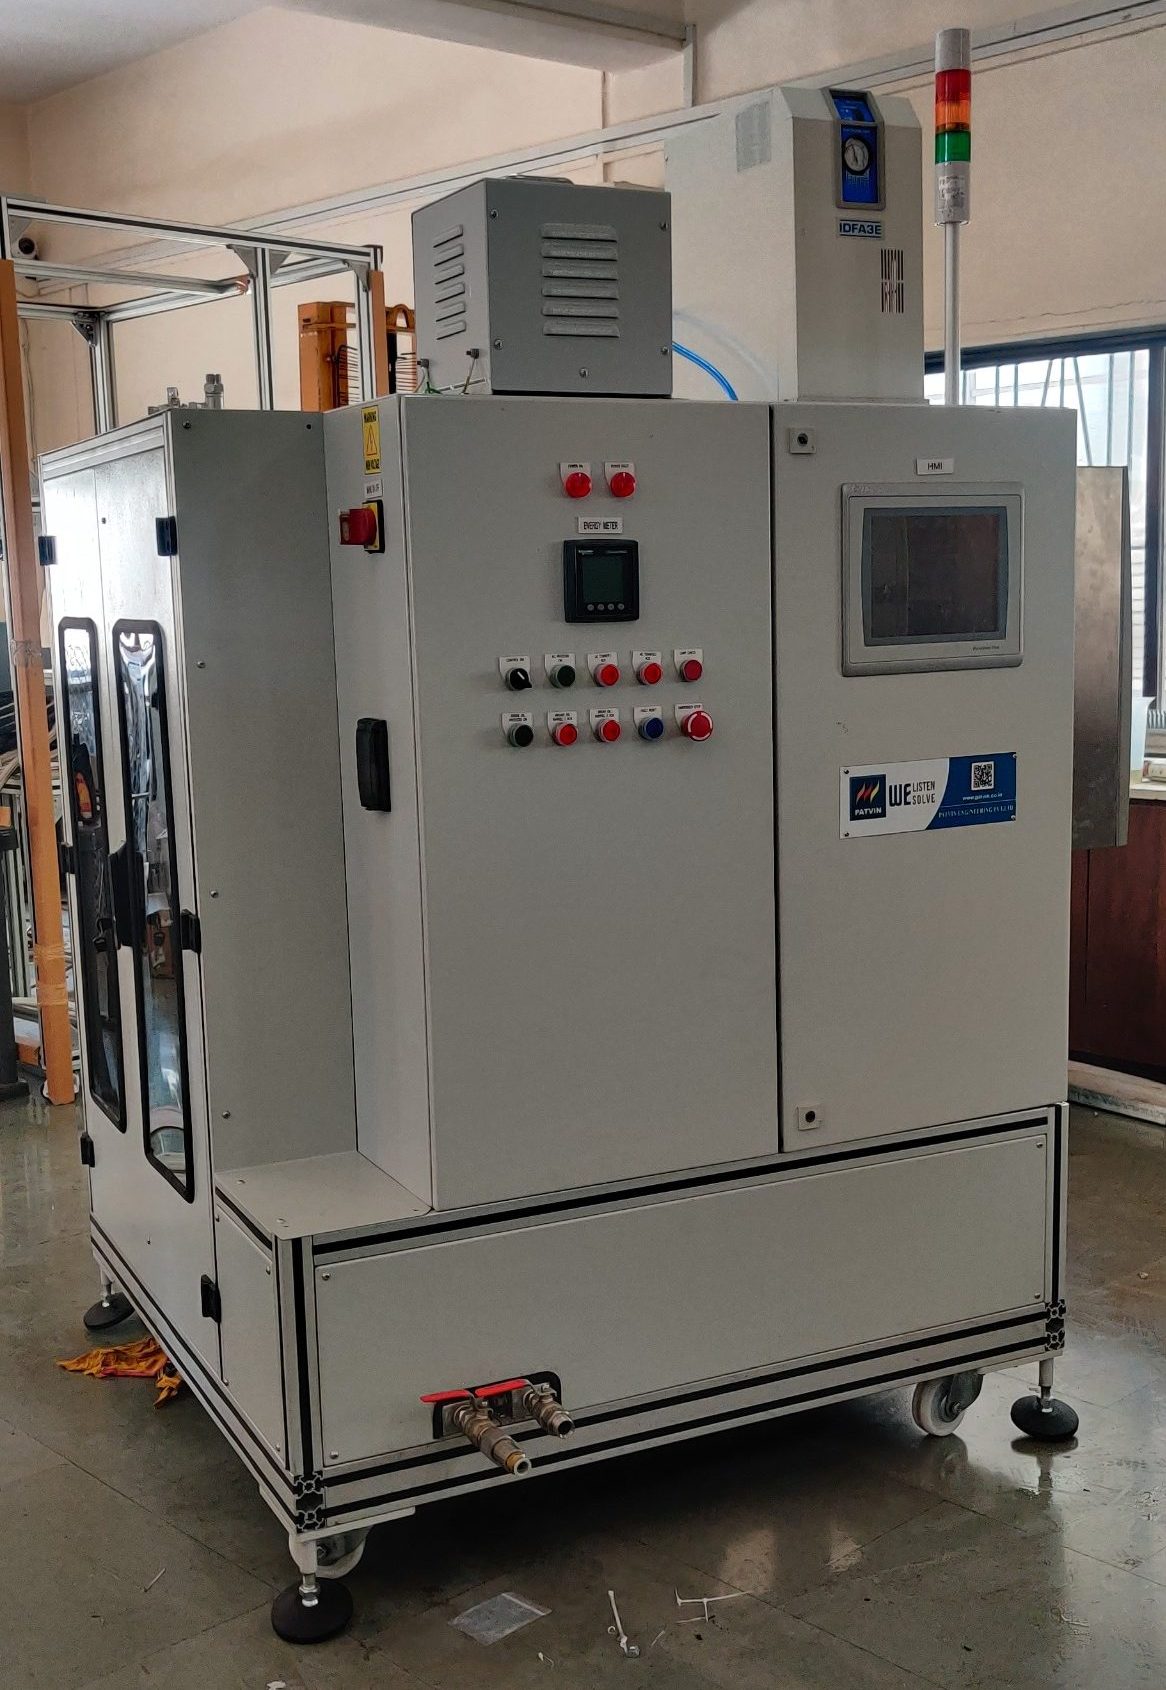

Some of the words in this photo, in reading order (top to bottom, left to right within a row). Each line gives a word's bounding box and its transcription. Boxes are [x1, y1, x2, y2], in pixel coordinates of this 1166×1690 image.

[839, 222, 882, 235] IDFA3E
[927, 462, 943, 471] HMI
[583, 521, 601, 530] ENERGY
[602, 521, 618, 530] METER
[912, 780, 936, 792] LISTEN
[888, 783, 912, 807] WE
[912, 793, 936, 805] SOLVE
[854, 807, 882, 816] PATVIN
